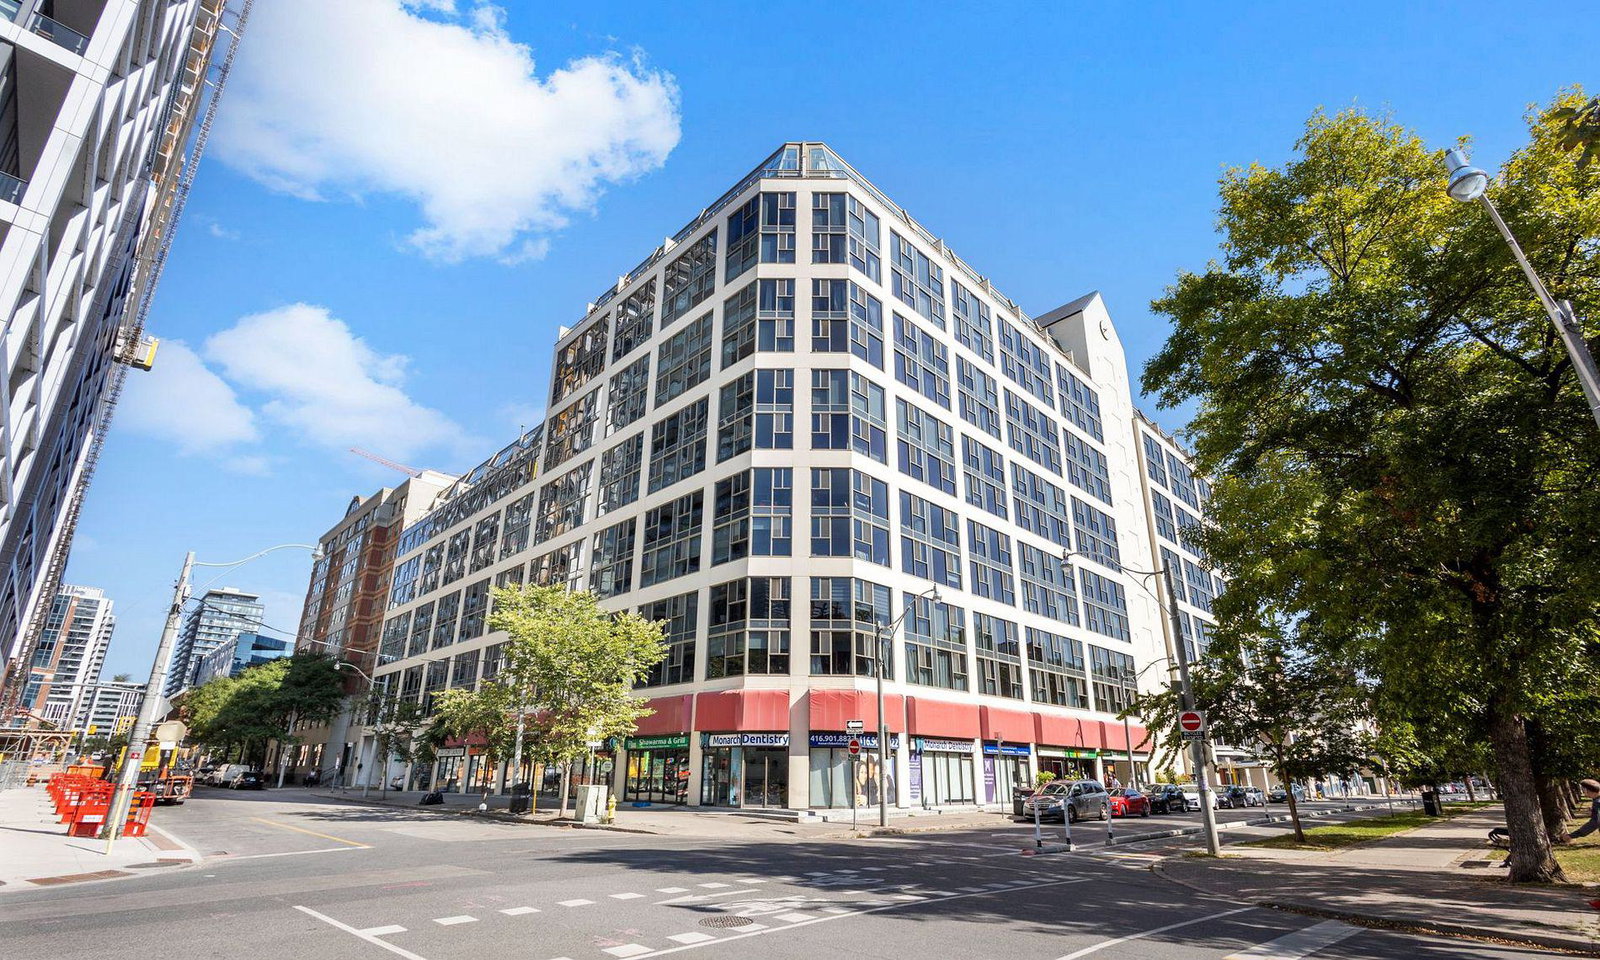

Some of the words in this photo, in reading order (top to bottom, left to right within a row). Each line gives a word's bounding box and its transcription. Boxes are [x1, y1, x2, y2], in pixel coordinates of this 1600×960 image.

[667, 737, 672, 745] &
[673, 736, 686, 744] Grill
[713, 735, 741, 745] Monarch
[742, 734, 789, 745] Dentistry
[924, 739, 947, 749] Monarch
[948, 741, 972, 752] Dentistry
